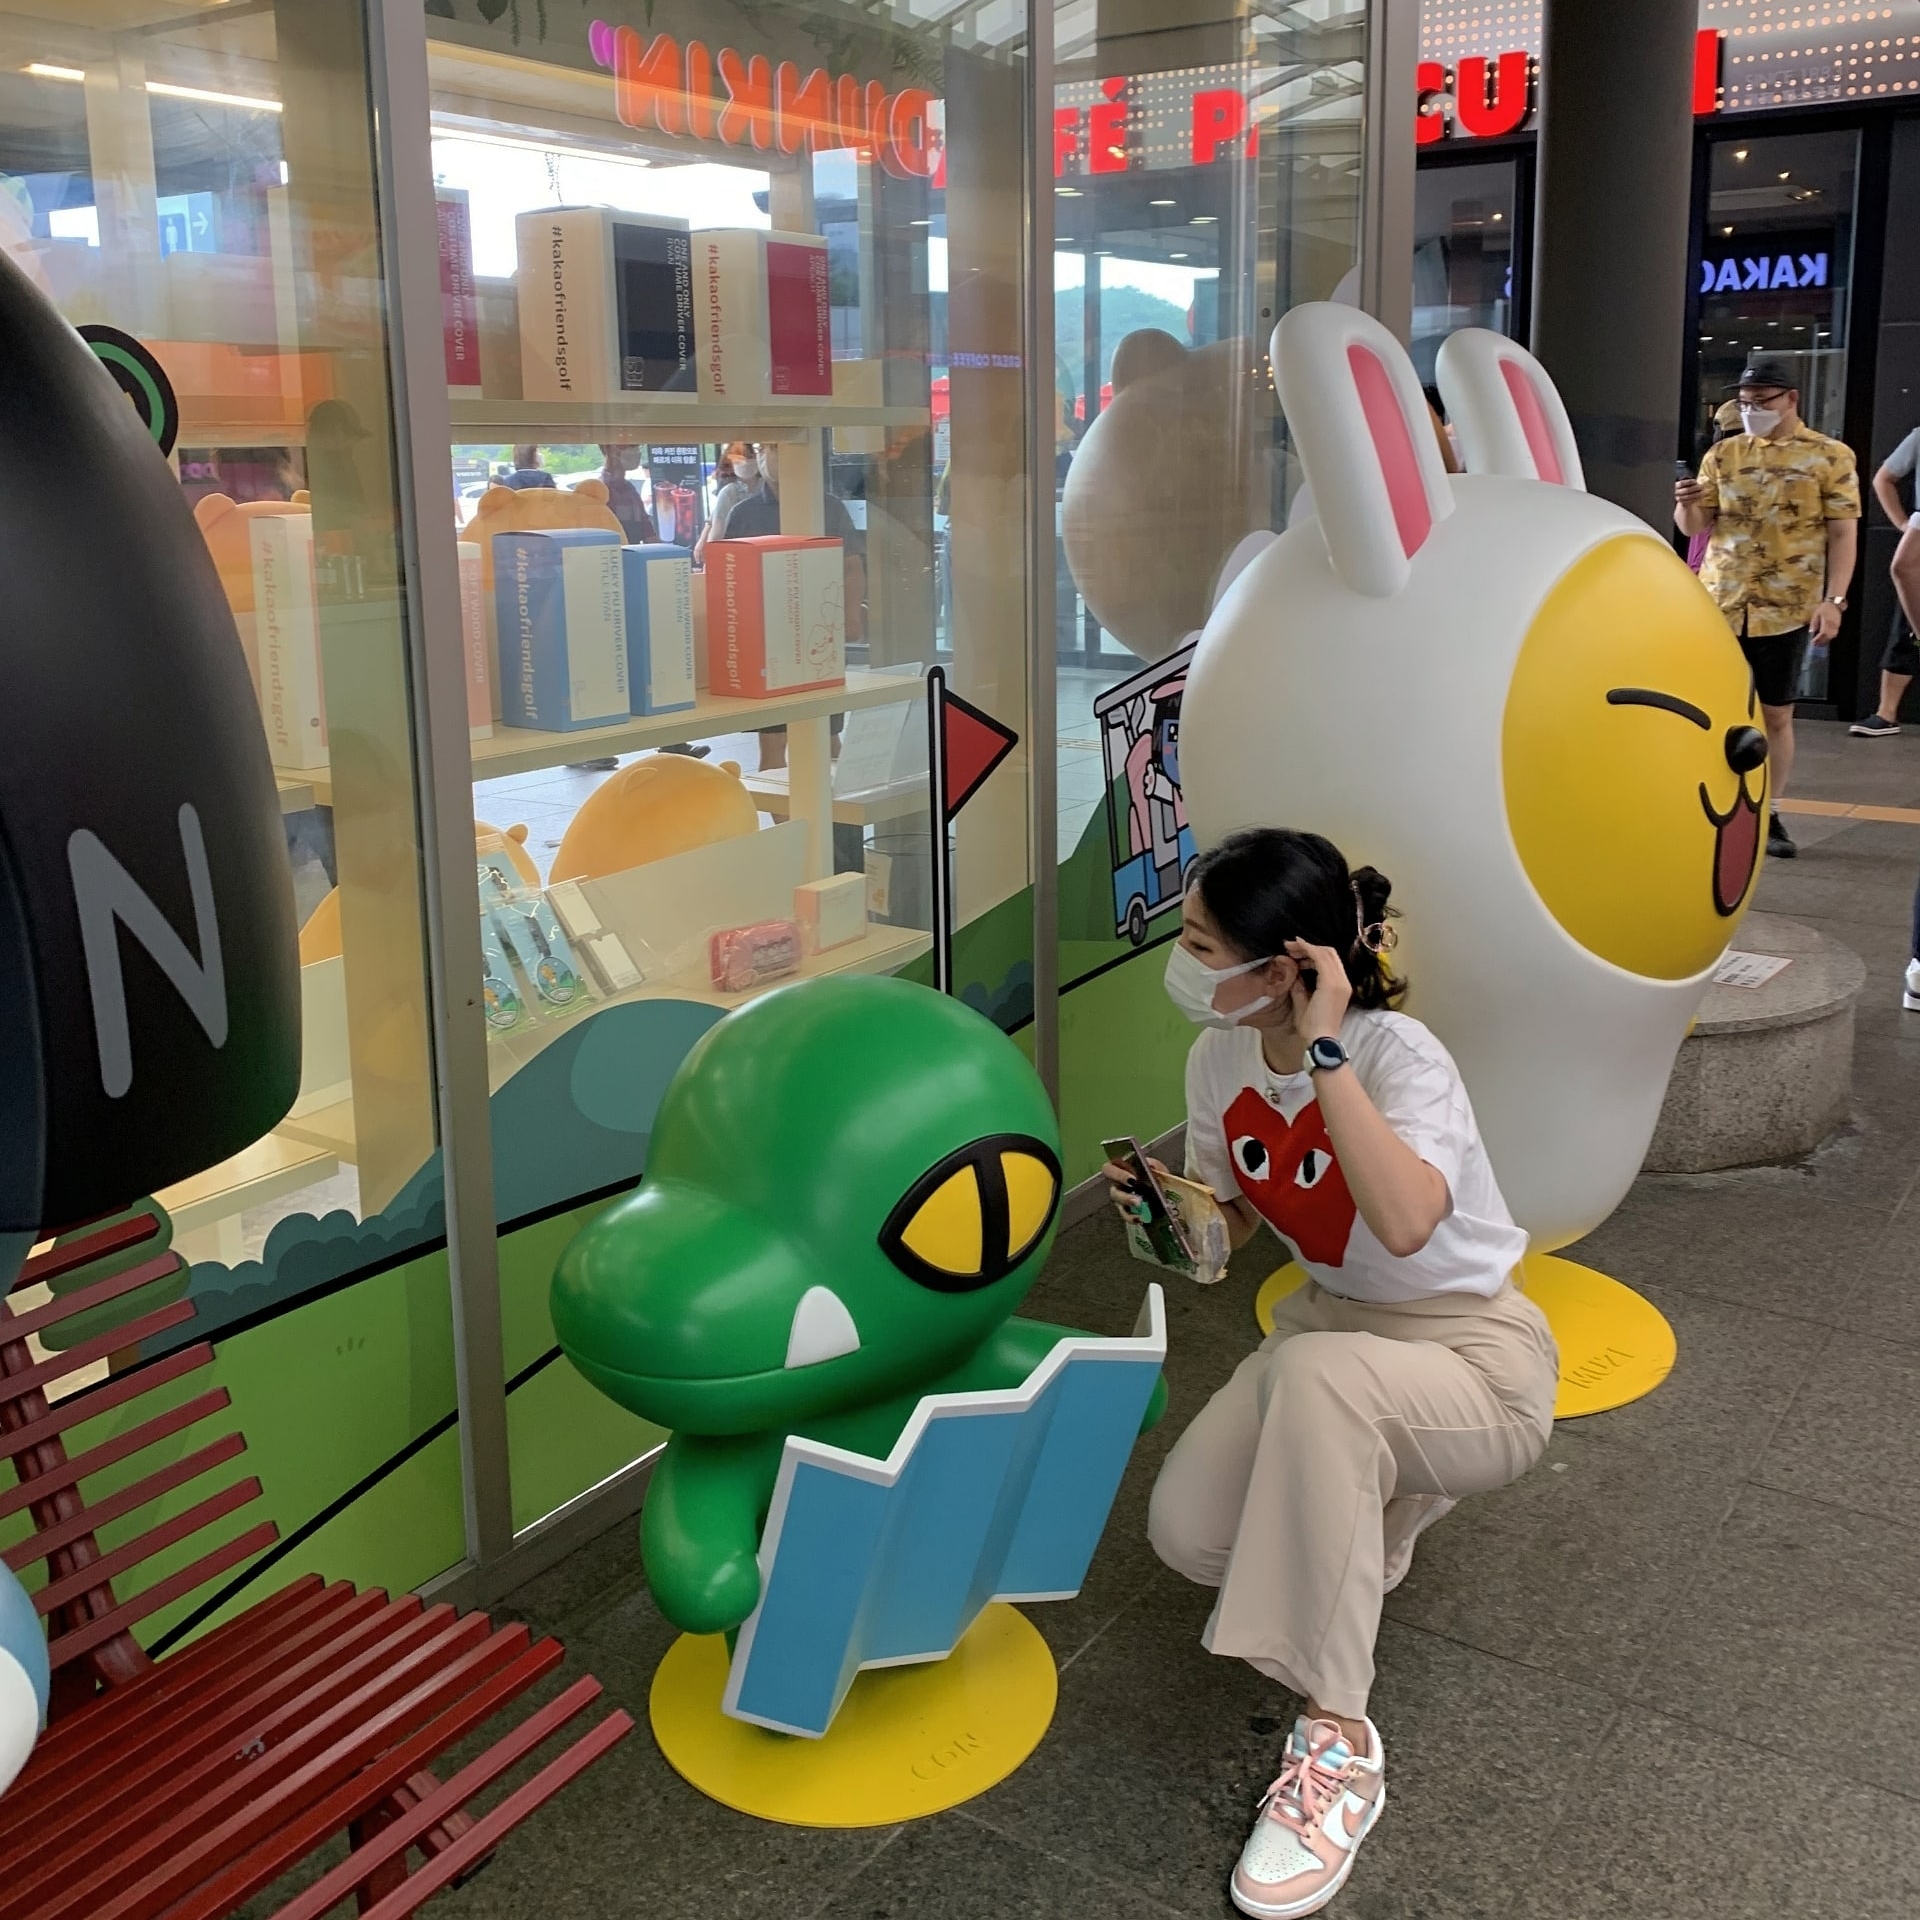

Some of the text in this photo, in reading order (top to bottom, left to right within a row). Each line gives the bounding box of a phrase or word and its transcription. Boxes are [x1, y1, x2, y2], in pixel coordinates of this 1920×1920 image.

[455, 321, 464, 361] COVER
[552, 225, 571, 392] #kakaofriendsgolf
[674, 238, 686, 371] COSTUME DRIVER COVER
[708, 243, 726, 396] #kakaofriendsgolf
[515, 547, 538, 721] #kakaofriendsgolf
[615, 654, 625, 693] COVER
[725, 552, 742, 690] #kakaofriendsgolf
[67, 802, 229, 1098] N
[1563, 1347, 1635, 1389] MUZI
